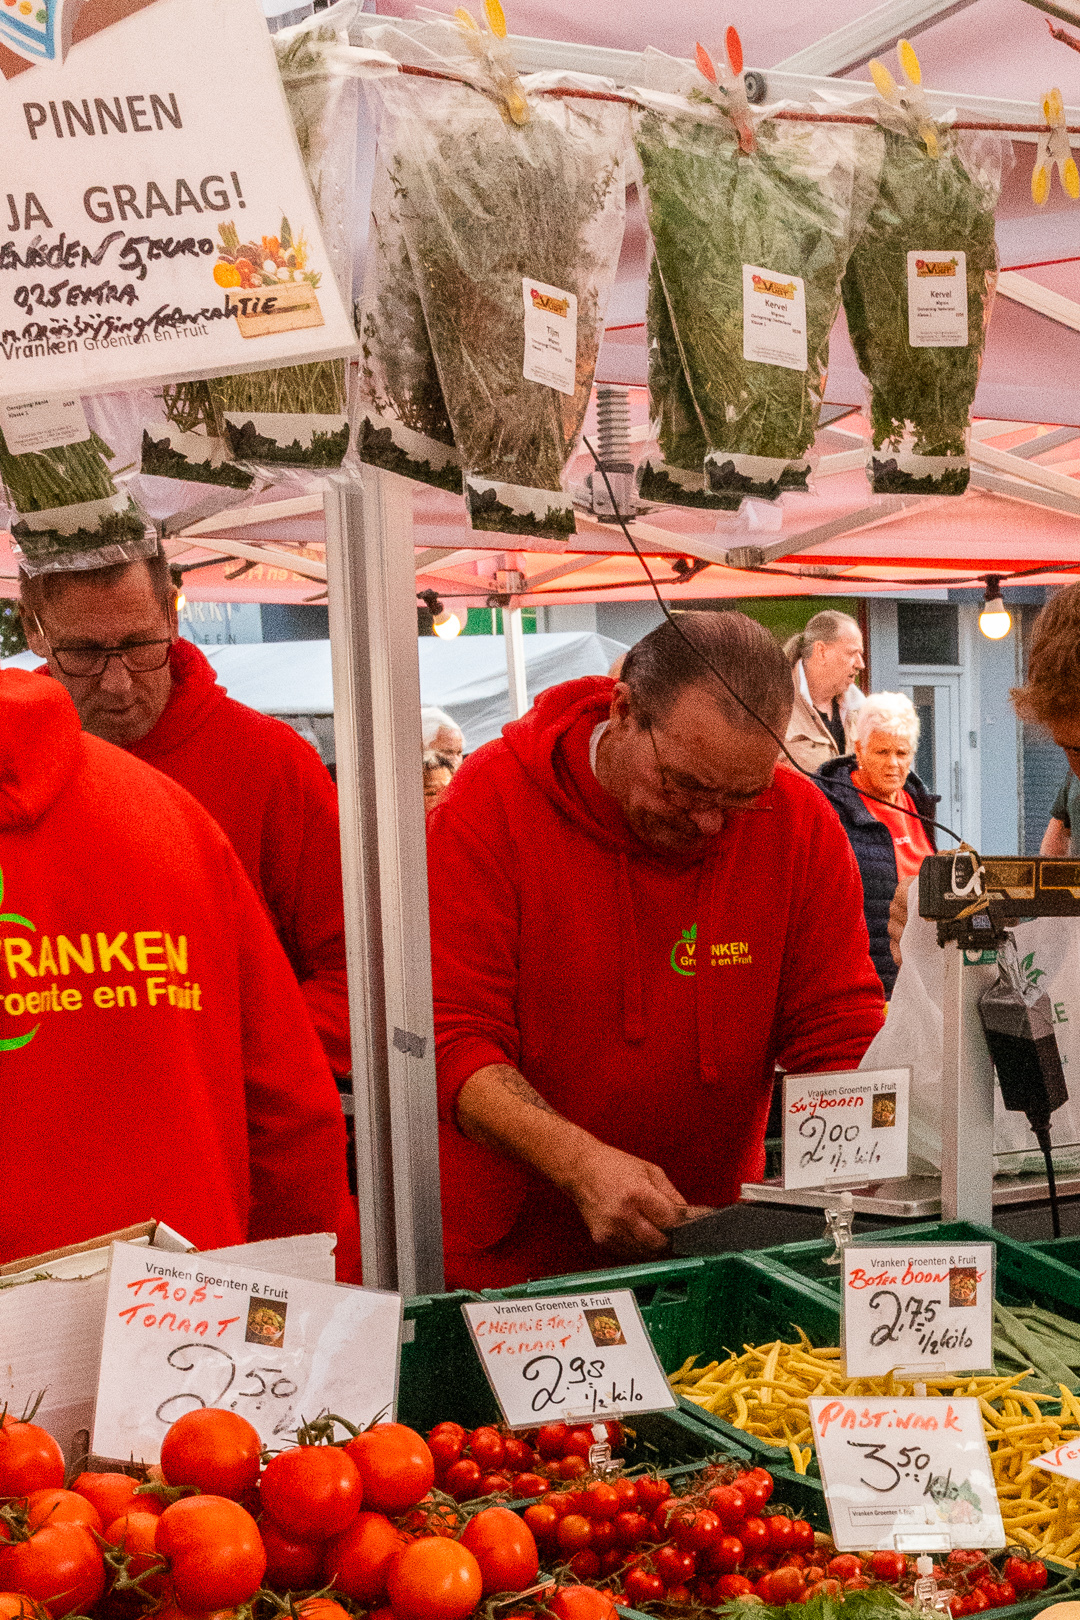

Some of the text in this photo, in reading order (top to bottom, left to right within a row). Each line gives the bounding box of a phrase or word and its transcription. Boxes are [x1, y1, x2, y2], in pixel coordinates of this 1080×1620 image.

[22, 92, 184, 141] PINNEN
[6, 171, 247, 232] JA GRAAG!
[154, 330, 173, 342] en
[176, 323, 210, 340] Fruit
[0, 930, 189, 980] RANKEN
[0, 976, 203, 1016] oente en Fruit
[807, 1081, 897, 1098] Vranken Groenten & Fruit
[871, 1254, 977, 1268] Vranken Groenten & Fruit
[145, 1261, 289, 1300] Vranken Groenten & Fruit
[118, 1302, 241, 1338] TOMAAT
[493, 1296, 613, 1316] Vranken Groenten & Fruit
[611, 1378, 644, 1404] kilo
